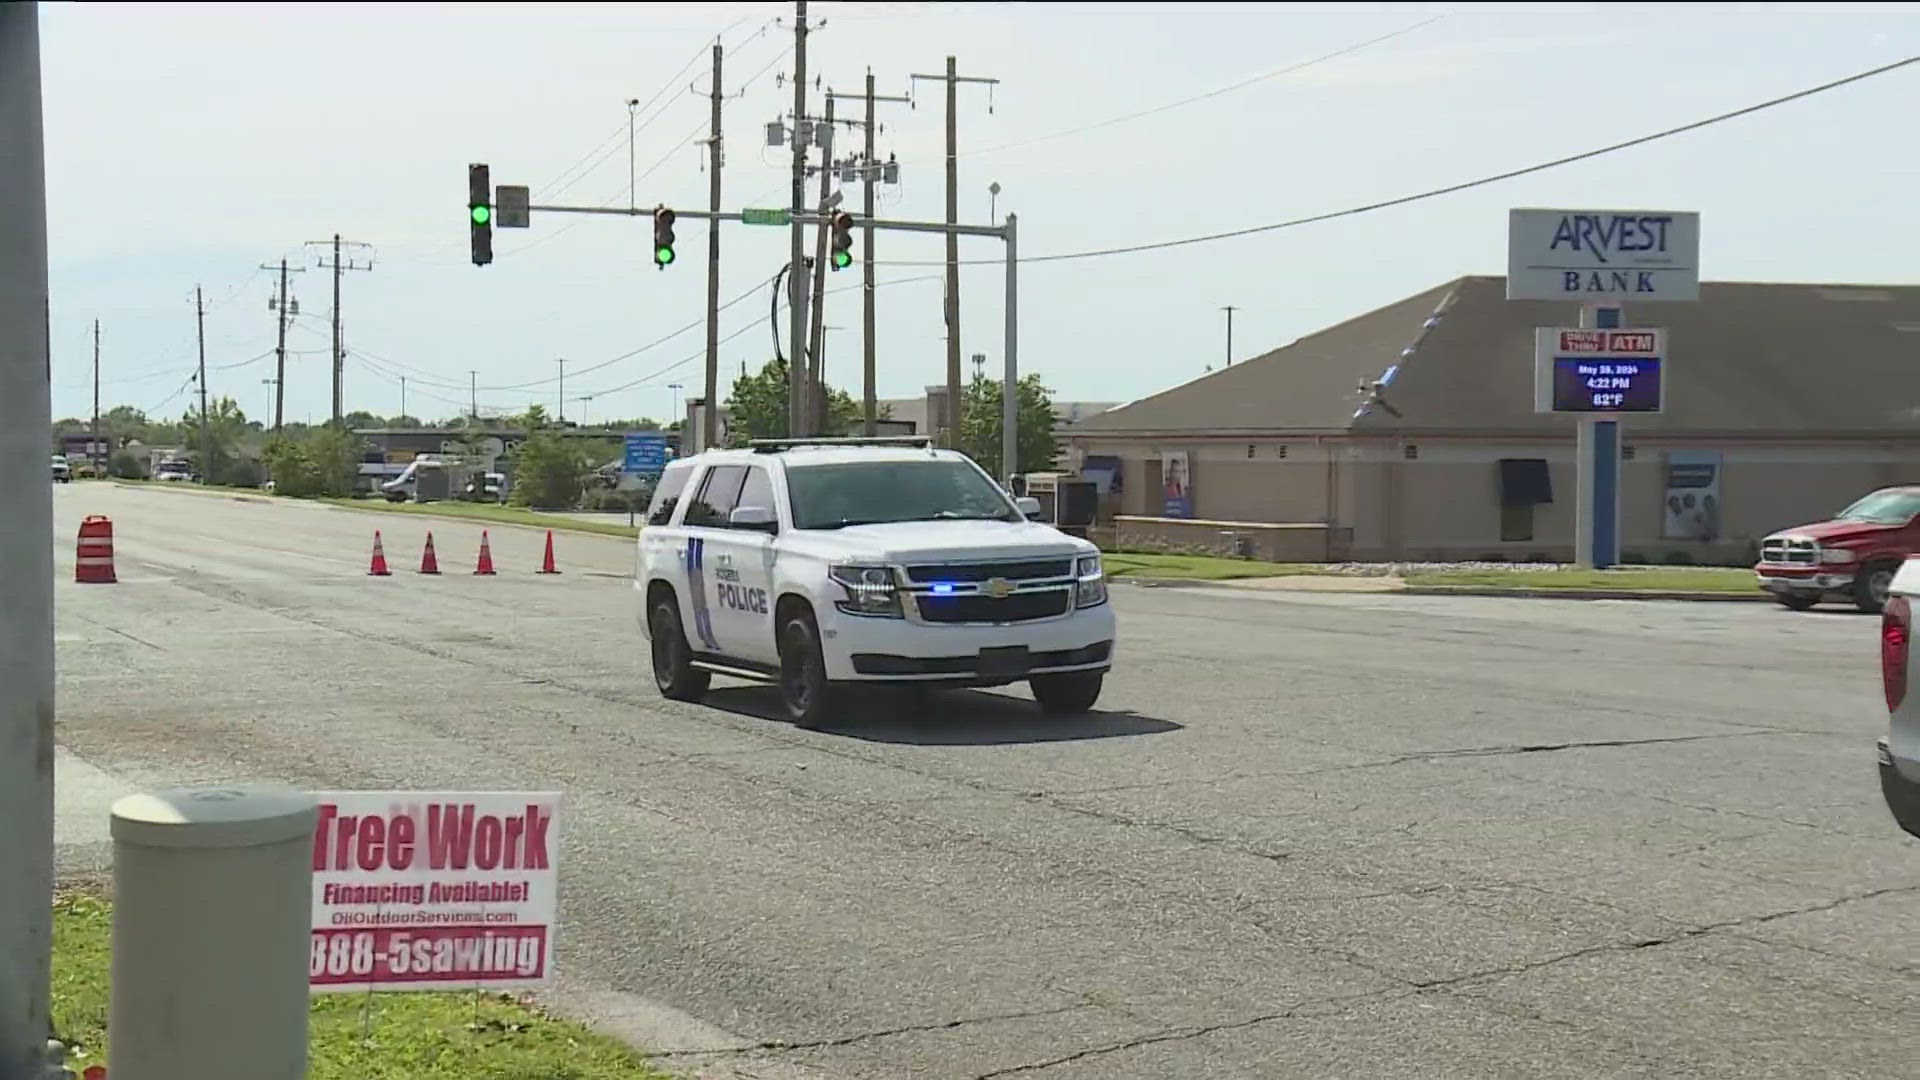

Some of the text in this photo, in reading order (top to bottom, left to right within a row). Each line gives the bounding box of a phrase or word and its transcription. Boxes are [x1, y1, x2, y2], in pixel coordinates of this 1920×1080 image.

[1550, 215, 1672, 262] ARVEST
[1564, 271, 1655, 292] BANK
[1566, 332, 1598, 341] DRIVE
[1567, 341, 1599, 350] THRU
[1613, 335, 1652, 350] ATM
[1579, 365, 1597, 376] May
[1587, 378, 1630, 388] 4:22 PM
[717, 583, 768, 614] POLICE
[312, 804, 551, 872] Tree Work
[323, 881, 529, 906] Financing Available!
[310, 932, 539, 977] 888-5sawing
